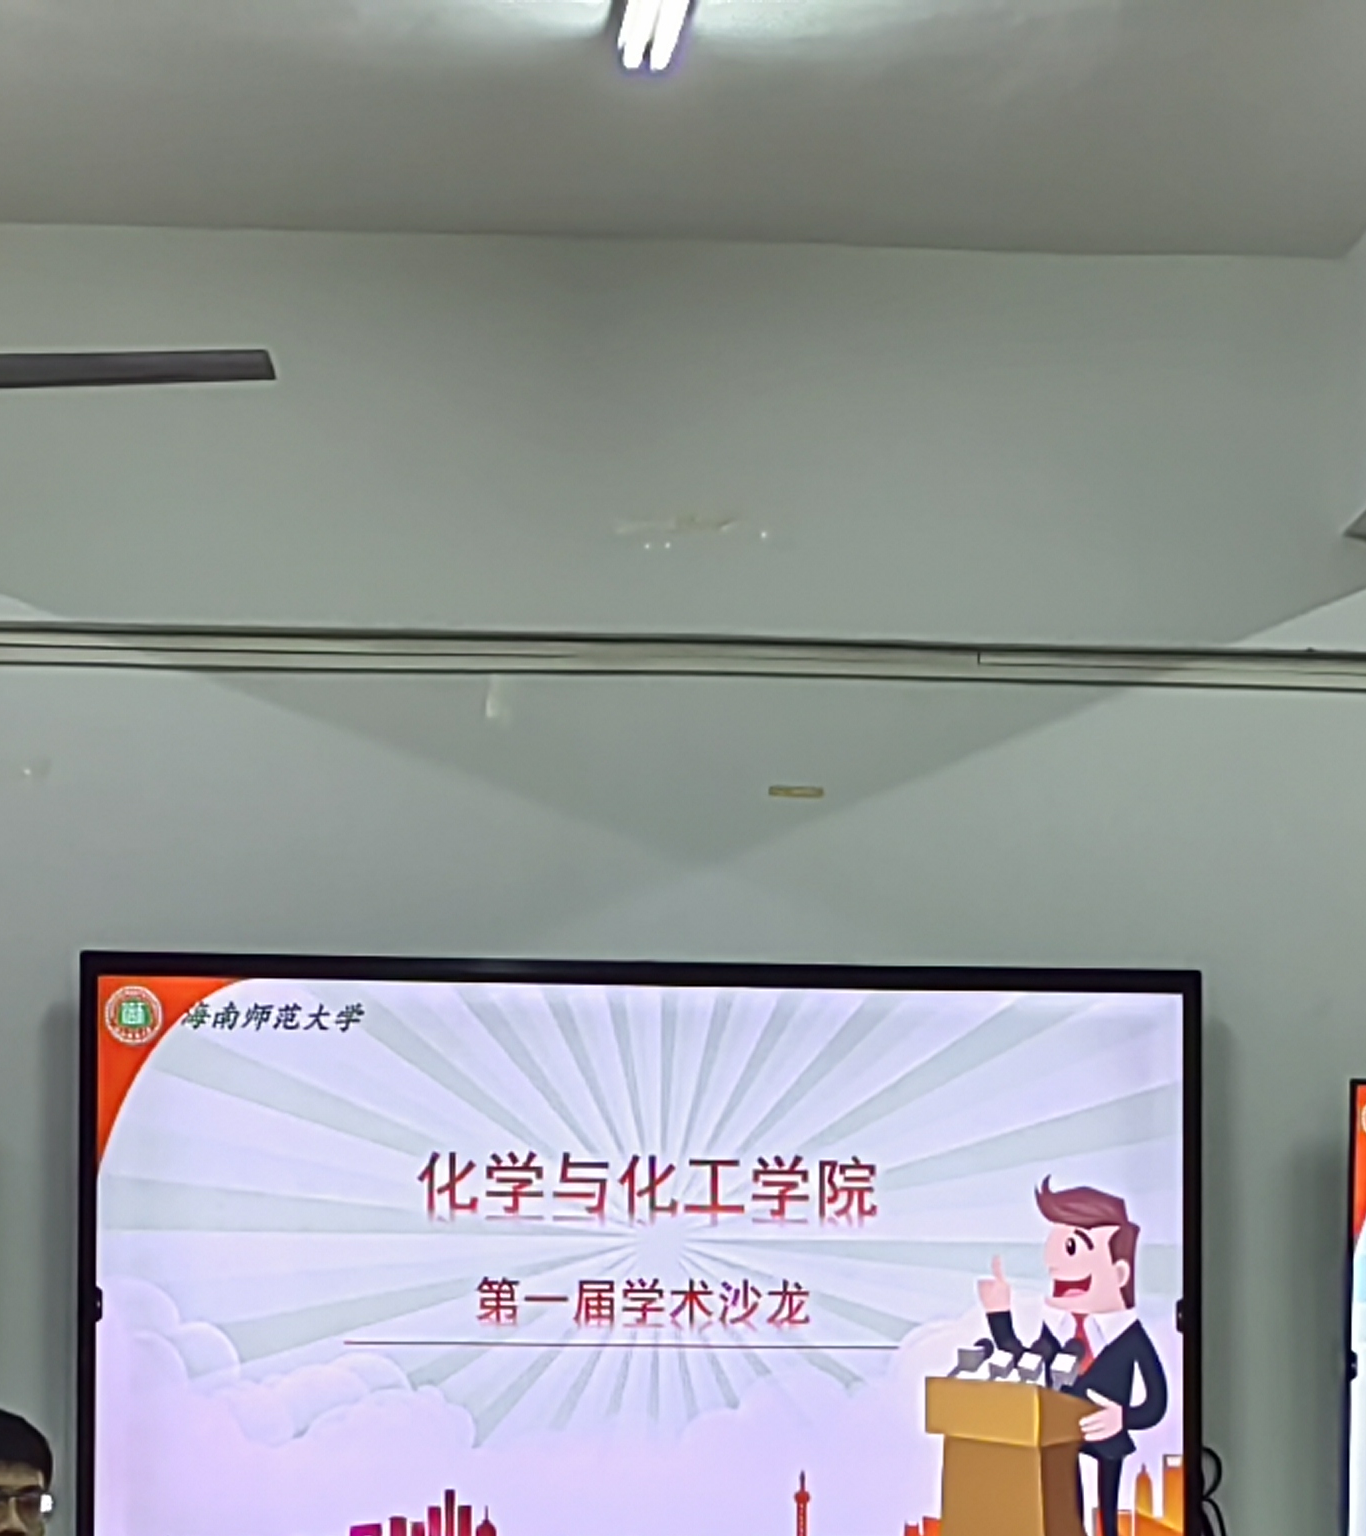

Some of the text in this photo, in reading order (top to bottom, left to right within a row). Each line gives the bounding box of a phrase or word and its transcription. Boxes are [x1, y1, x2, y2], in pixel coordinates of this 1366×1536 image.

[417, 1151, 878, 1219] 化学与化工学院
[476, 1276, 810, 1325] 第一届学术沙龙
